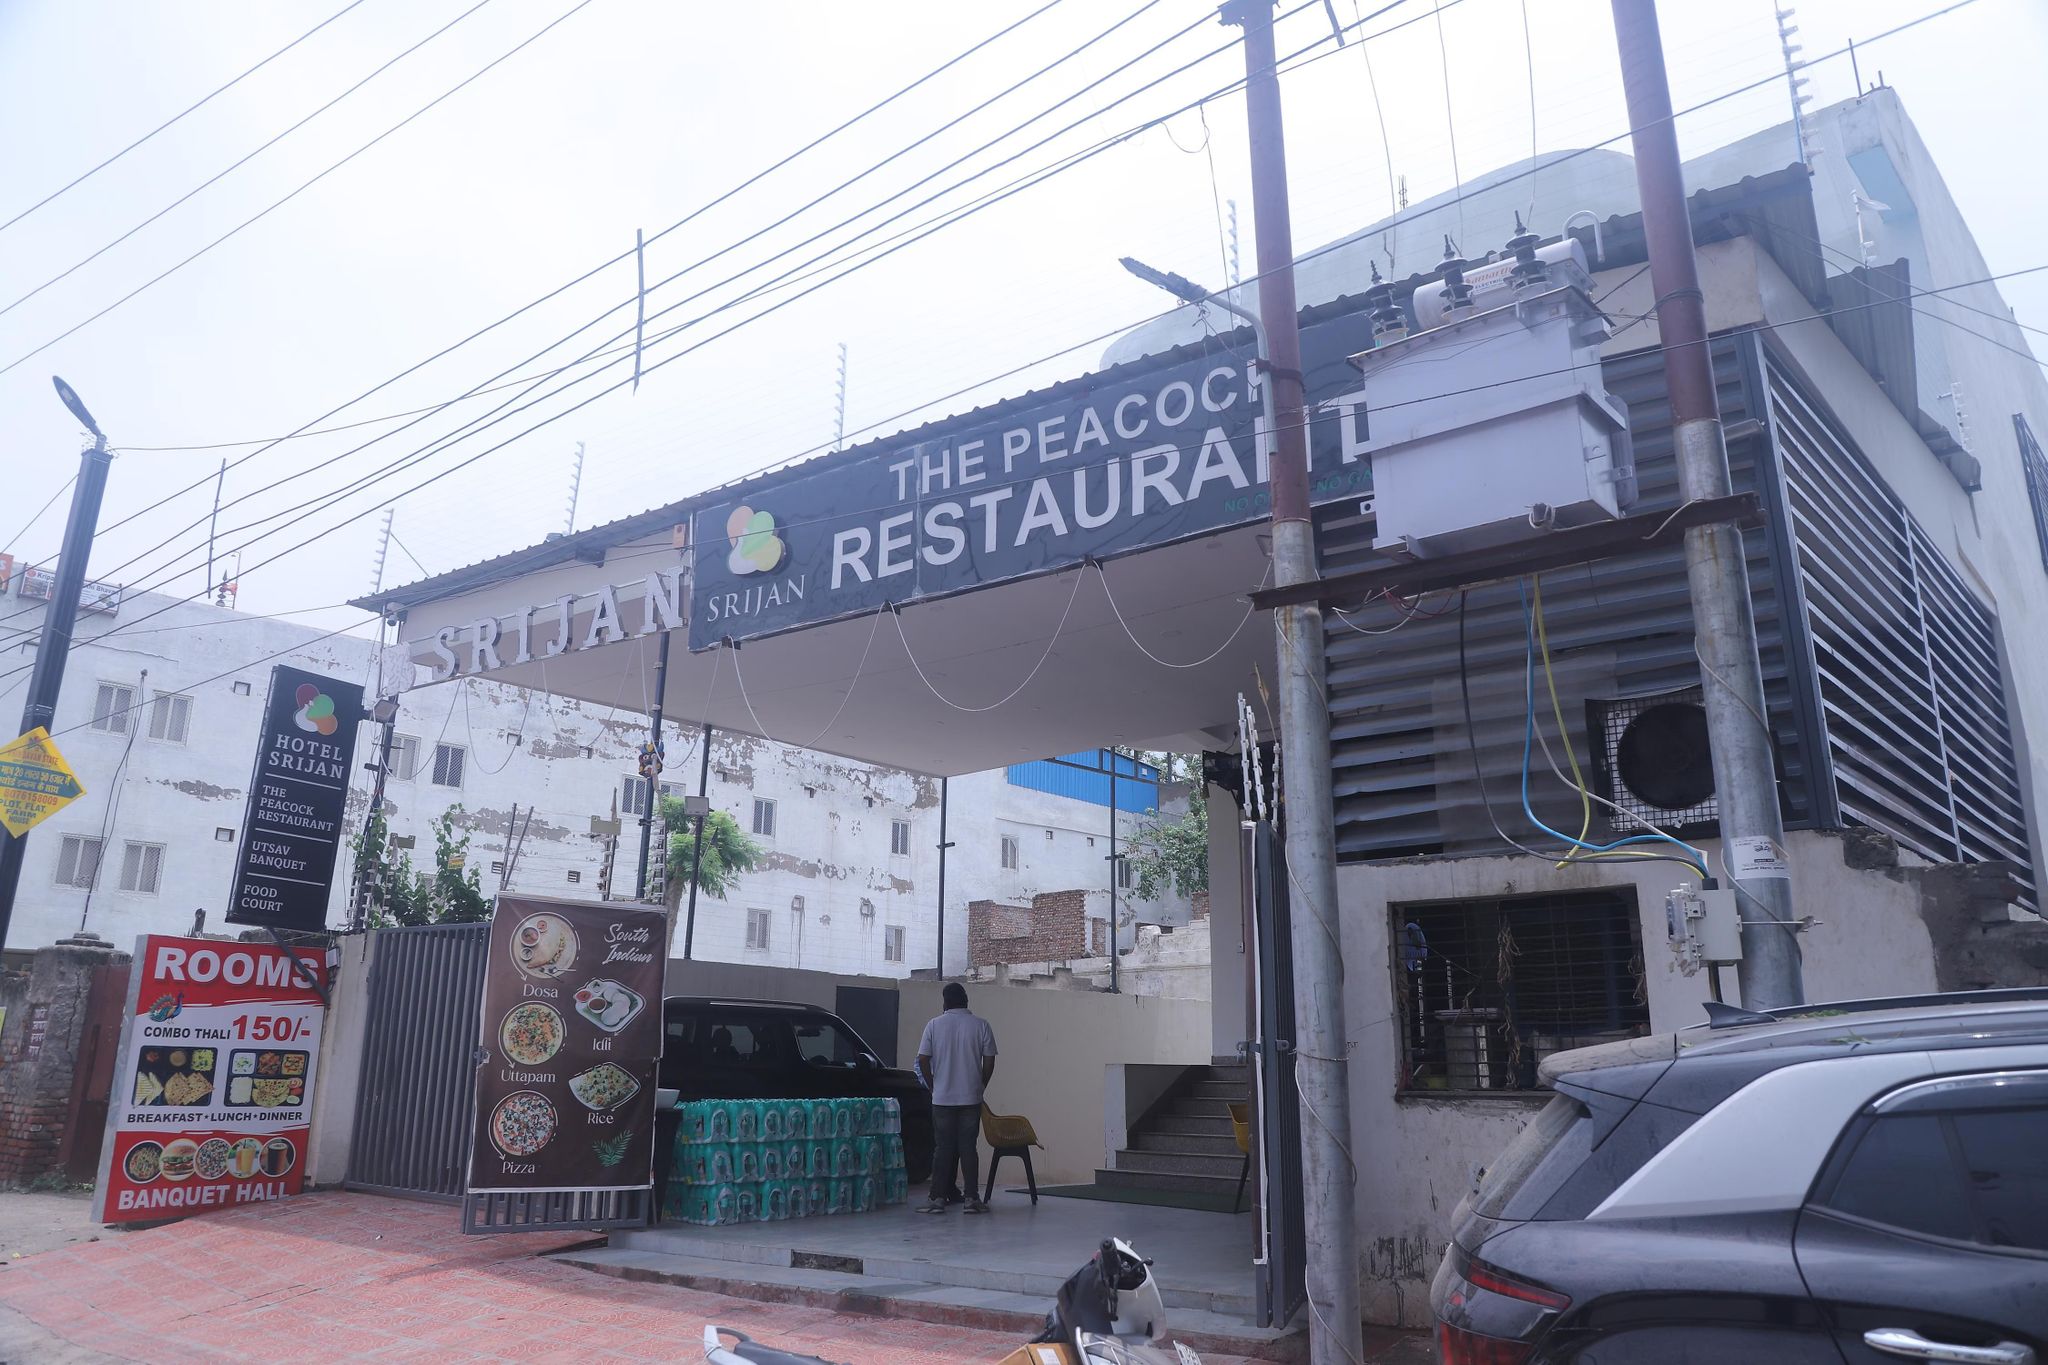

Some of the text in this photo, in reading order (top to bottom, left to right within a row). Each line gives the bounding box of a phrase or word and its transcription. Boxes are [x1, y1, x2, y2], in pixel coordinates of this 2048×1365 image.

[888, 440, 986, 502] THE
[706, 574, 806, 622] SRIJAN
[431, 566, 687, 681] SRIJAN
[275, 734, 343, 761] HOTEL
[268, 751, 345, 779] SRIJAN
[263, 784, 287, 798] THE
[260, 797, 315, 816] PEACOCK
[257, 809, 334, 832] RESTAURANT
[252, 840, 291, 856] UTSAV
[249, 853, 306, 871] BANQUET
[244, 884, 277, 898] FOOD
[241, 897, 283, 912] COURT
[604, 923, 649, 944] South
[601, 943, 653, 965] Indian
[153, 946, 319, 989] ROOMS
[523, 983, 559, 998] Dosa
[144, 1026, 191, 1039] COMBO
[195, 1028, 231, 1040] THALI
[592, 1037, 612, 1051] Idli
[500, 1069, 556, 1085] Uttapam
[127, 1111, 303, 1124] BREAKFAST LUNCH DINNER
[587, 1112, 614, 1125] Rice
[502, 1160, 536, 1175] Pizza
[118, 1181, 290, 1211] BANQUET HALL
